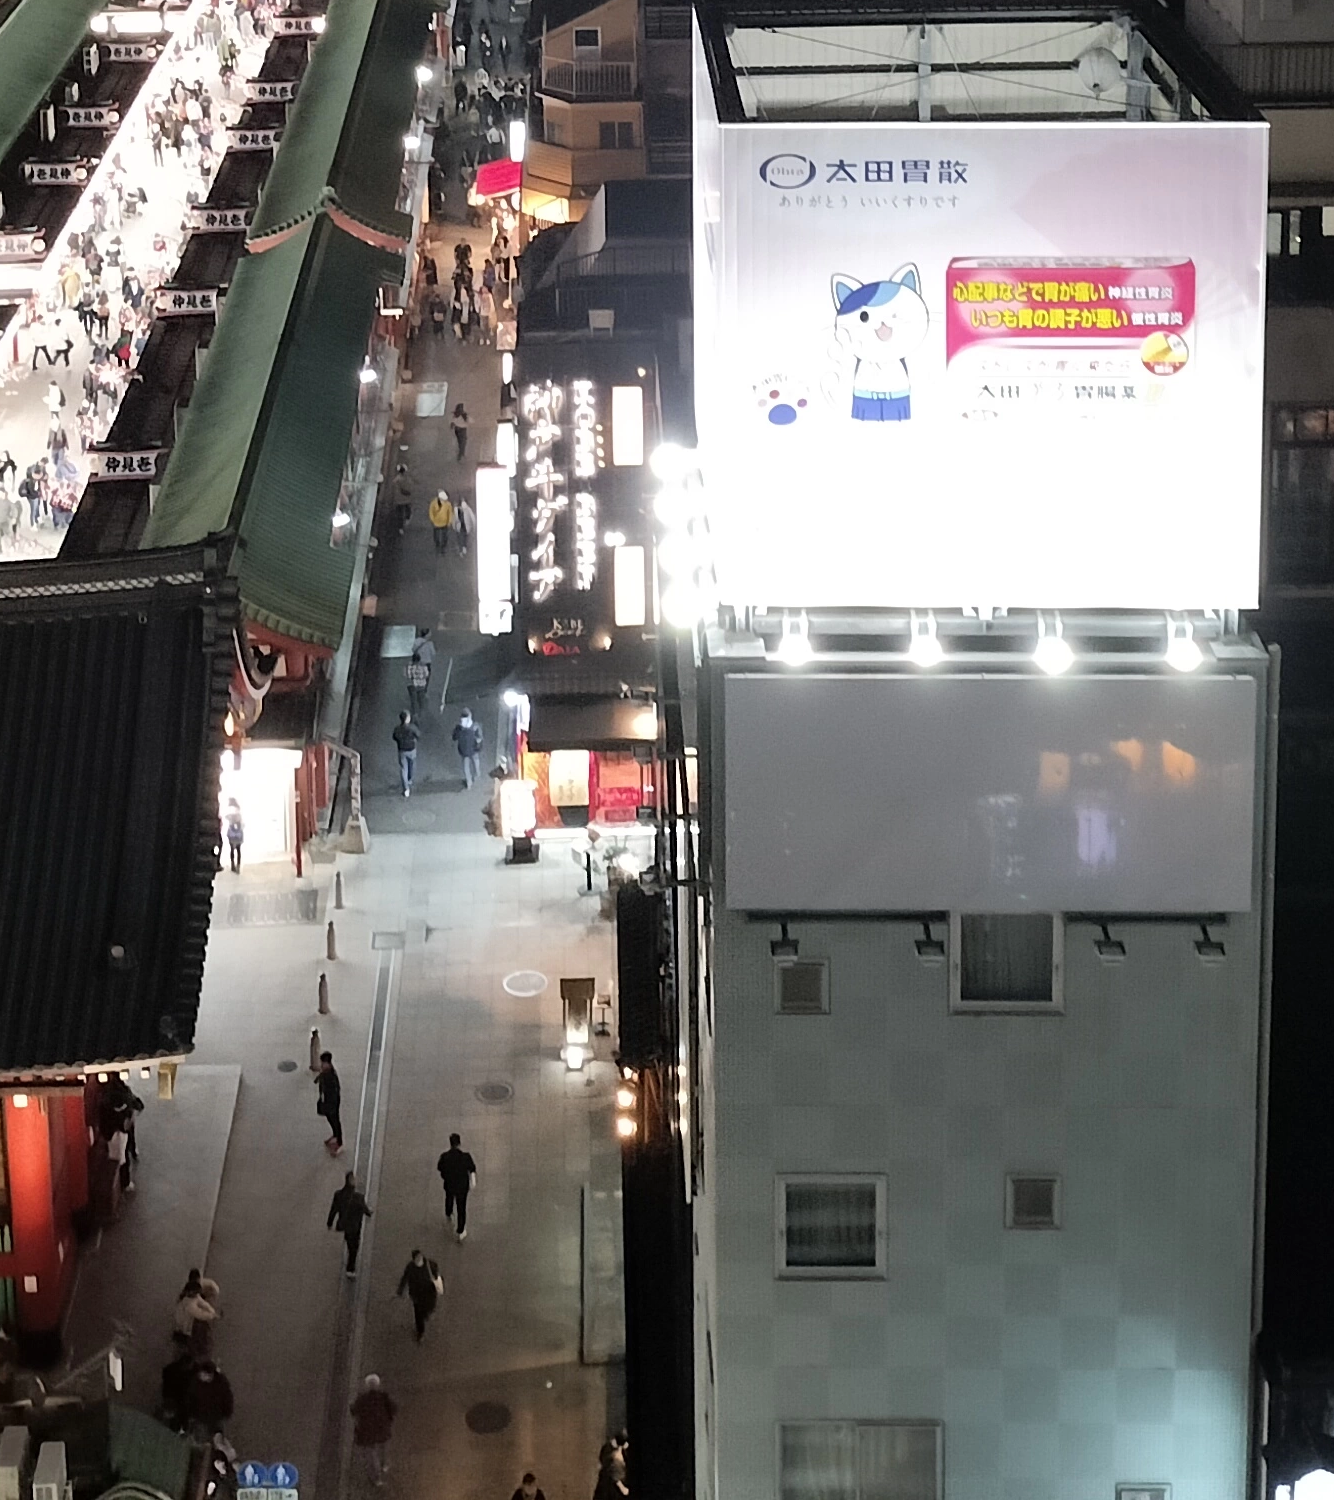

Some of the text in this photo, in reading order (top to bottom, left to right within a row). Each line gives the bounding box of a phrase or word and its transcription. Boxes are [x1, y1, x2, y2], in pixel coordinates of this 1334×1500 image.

[826, 159, 969, 184] 太田胃散
[779, 195, 960, 209] ありがとう いいくすりです
[953, 282, 1105, 302] 心配事などで胃が痛い
[971, 308, 1129, 329] いつも胃の調子が悪い
